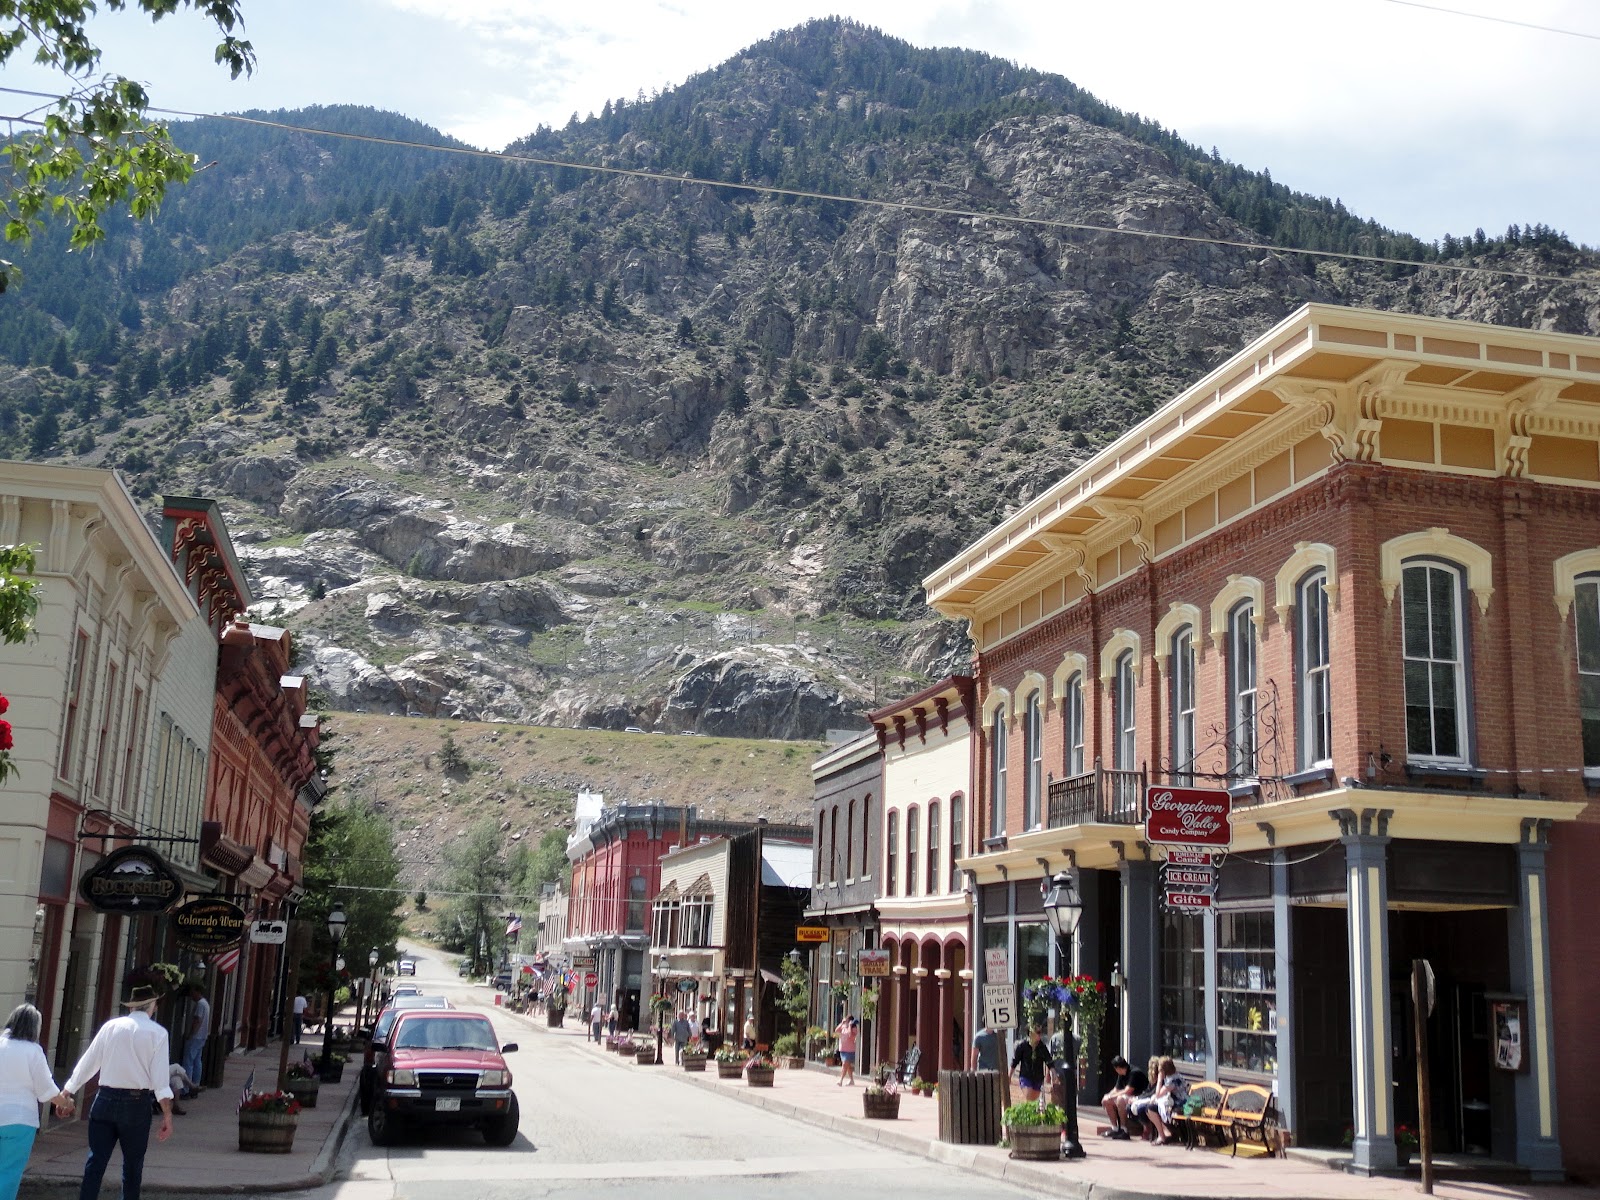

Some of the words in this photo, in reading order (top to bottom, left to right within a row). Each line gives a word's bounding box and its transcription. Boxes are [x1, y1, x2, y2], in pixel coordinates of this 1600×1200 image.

[1152, 791, 1225, 818] Georgetown
[1181, 812, 1222, 834] Valley
[1160, 827, 1180, 836] Candy
[1180, 828, 1209, 837] Company
[1175, 856, 1204, 864] Candy
[1170, 871, 1182, 881] ICE
[1183, 872, 1209, 882] CREAM
[1173, 895, 1203, 904] Gifts
[178, 914, 218, 926] Colorado
[219, 916, 243, 927] Wear
[992, 952, 1001, 960] NO
[986, 987, 1013, 996] SPEED
[991, 1007, 1010, 1024] 15
